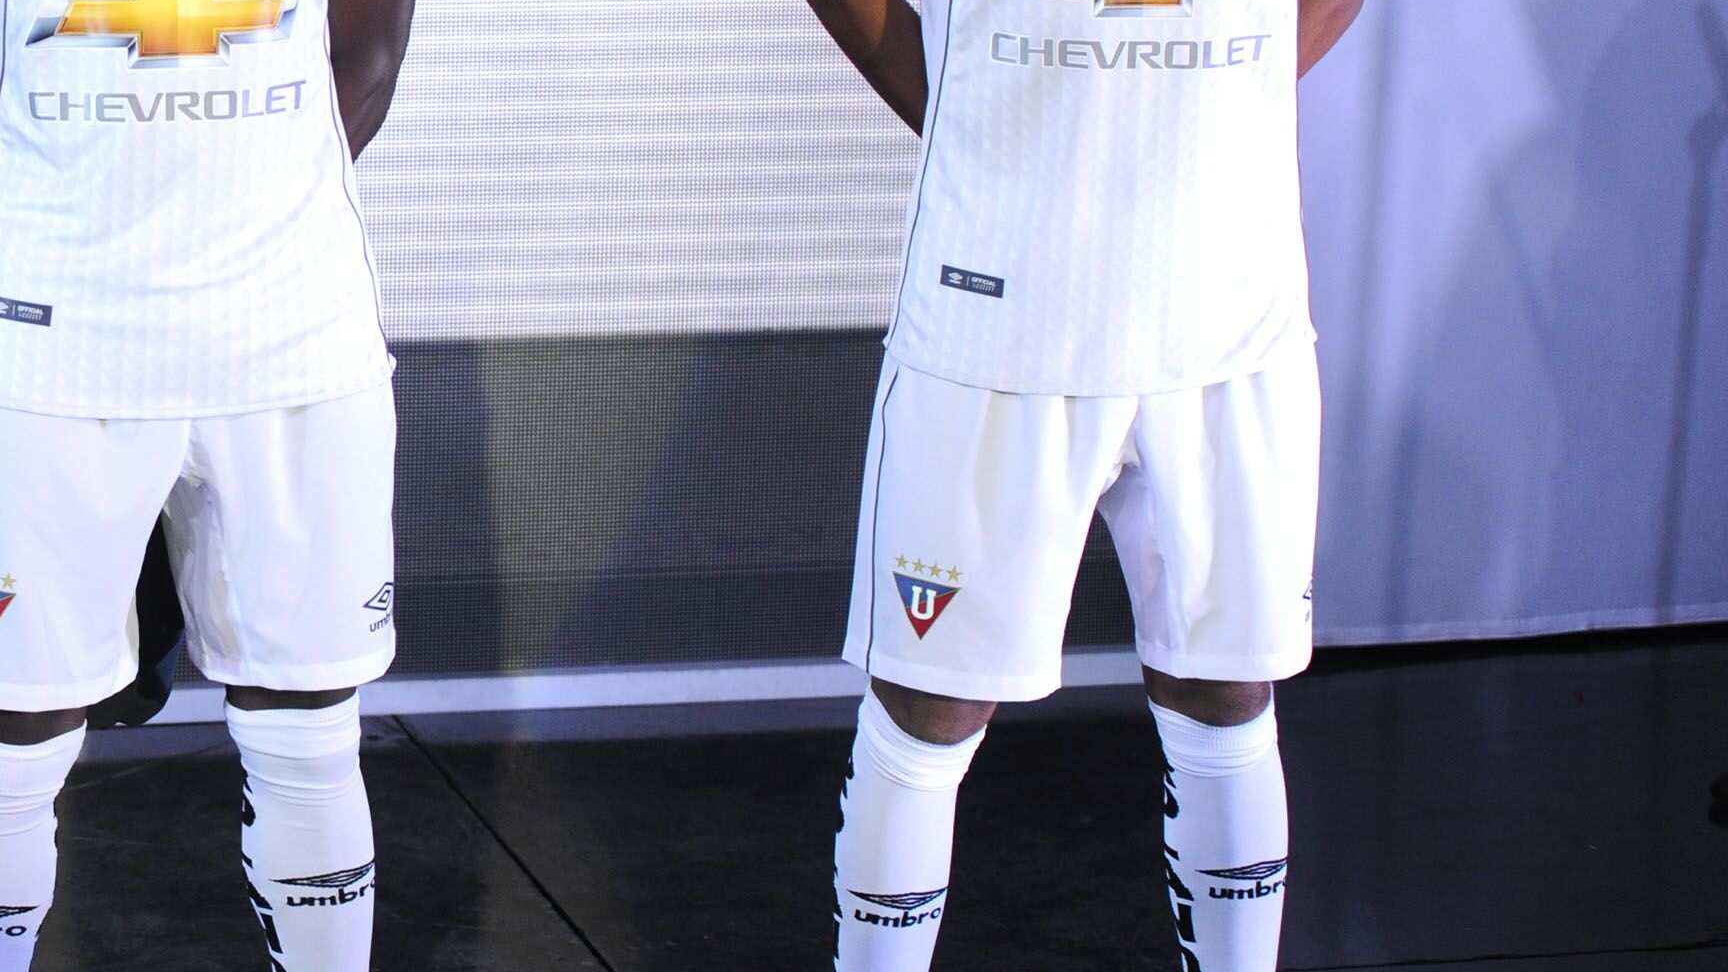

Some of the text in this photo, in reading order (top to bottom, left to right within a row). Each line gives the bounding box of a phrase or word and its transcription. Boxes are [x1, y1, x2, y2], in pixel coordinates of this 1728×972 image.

[991, 31, 1272, 70] CHEVROLET
[28, 79, 307, 122] CHEVROLET
[910, 584, 937, 620] U
[854, 907, 941, 928] umbro
